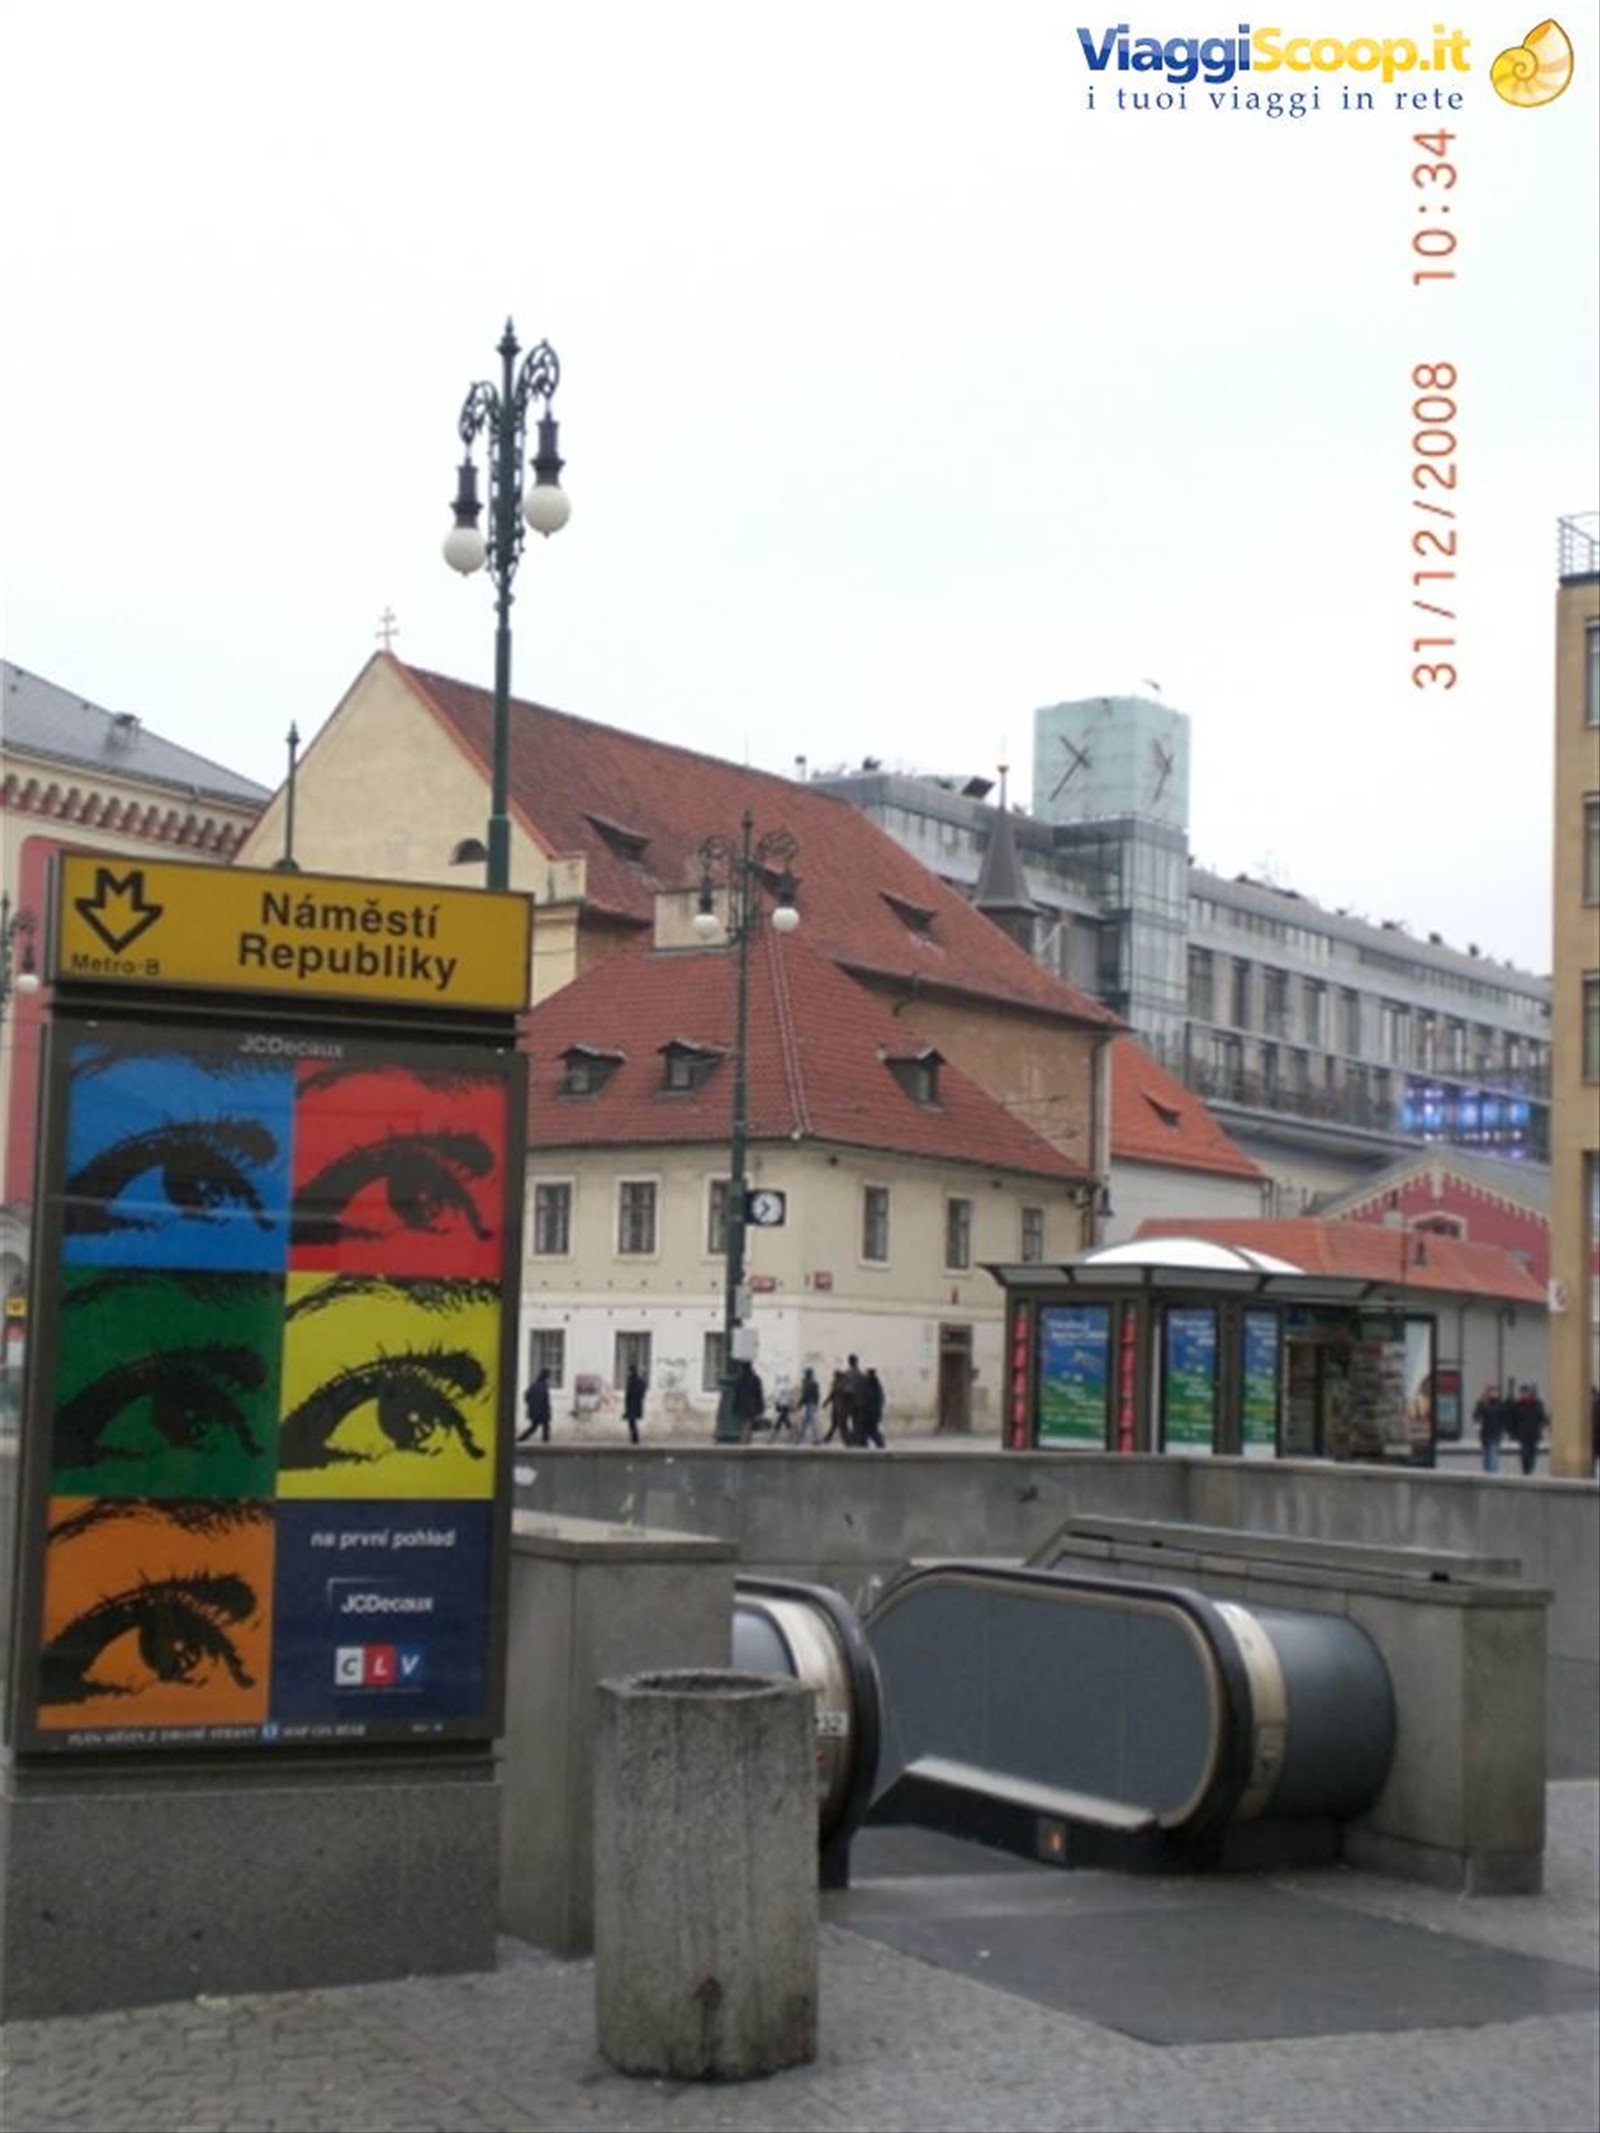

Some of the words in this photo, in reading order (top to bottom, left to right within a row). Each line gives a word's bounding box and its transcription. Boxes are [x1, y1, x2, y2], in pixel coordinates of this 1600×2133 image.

[262, 891, 440, 939] Náměstí
[239, 932, 457, 991] Republiky
[311, 1532, 335, 1547] na
[341, 1594, 434, 1613] JCDecaux
